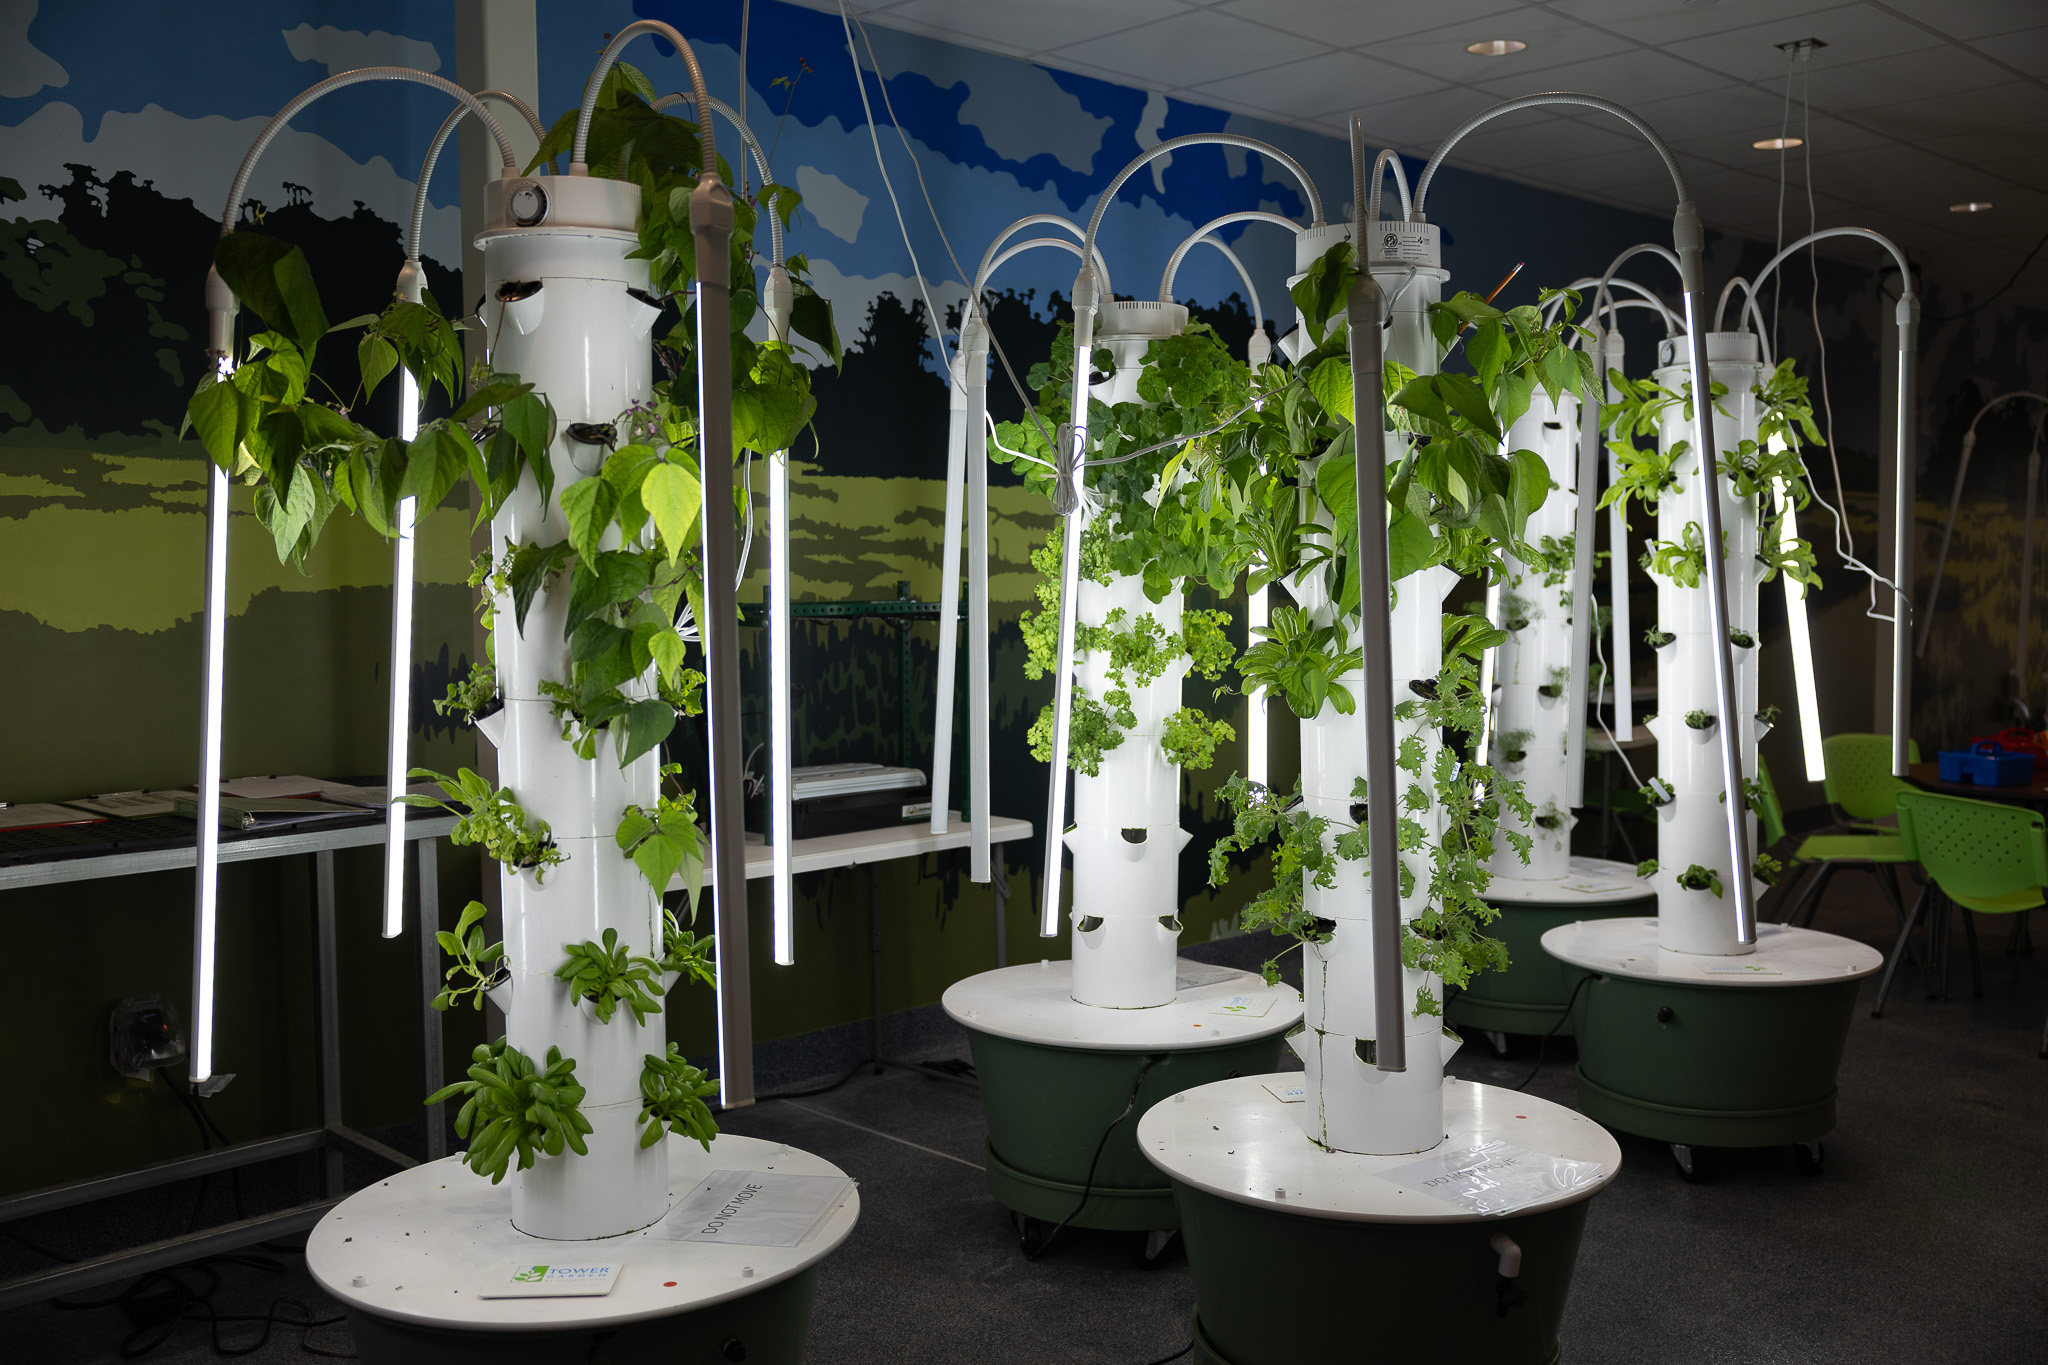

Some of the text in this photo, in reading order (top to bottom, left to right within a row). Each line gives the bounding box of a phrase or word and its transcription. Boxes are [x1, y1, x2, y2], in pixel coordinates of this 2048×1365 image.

[1422, 1177, 1449, 1187] DO
[1477, 1158, 1522, 1172] MOVE
[701, 1183, 763, 1234] DO NOT MOVE
[549, 1267, 609, 1275] TOWER
